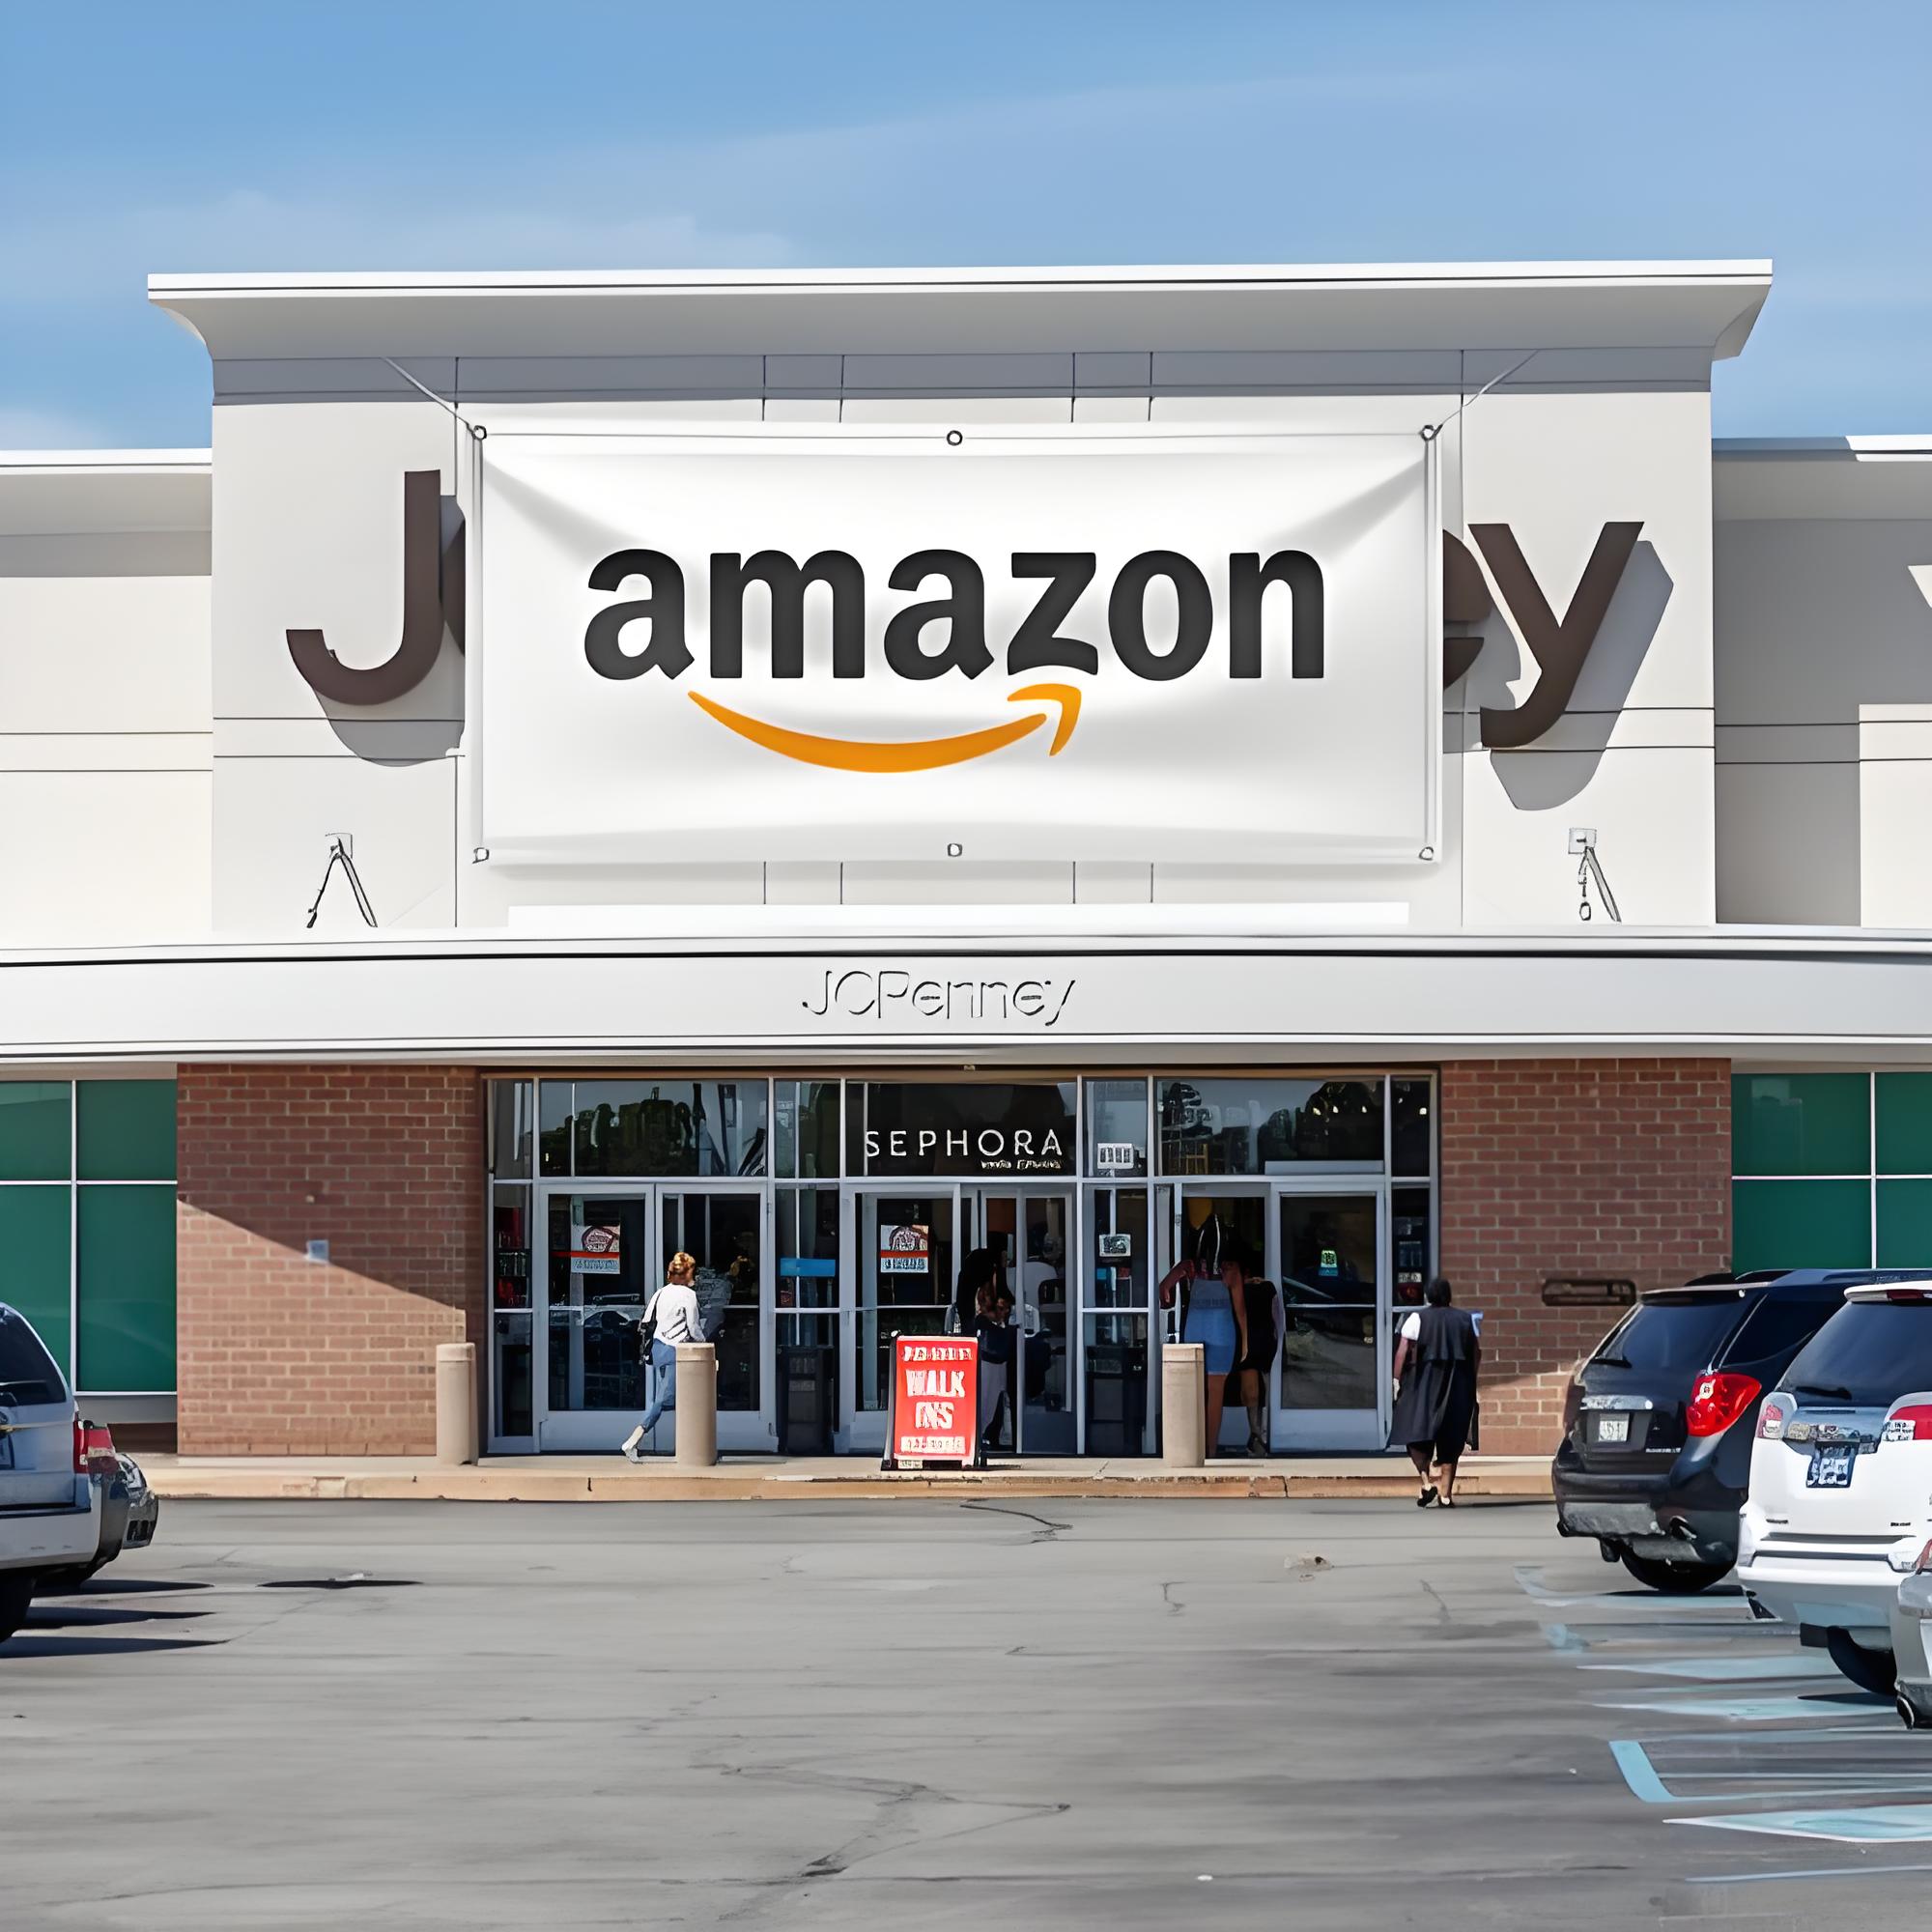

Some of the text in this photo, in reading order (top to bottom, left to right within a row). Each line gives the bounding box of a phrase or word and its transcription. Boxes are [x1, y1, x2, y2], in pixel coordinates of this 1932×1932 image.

[584, 549, 1323, 680] amazon
[802, 970, 1075, 1026] JCPenney
[867, 1129, 1062, 1156] SEPHORA
[906, 1370, 965, 1397] WALK
